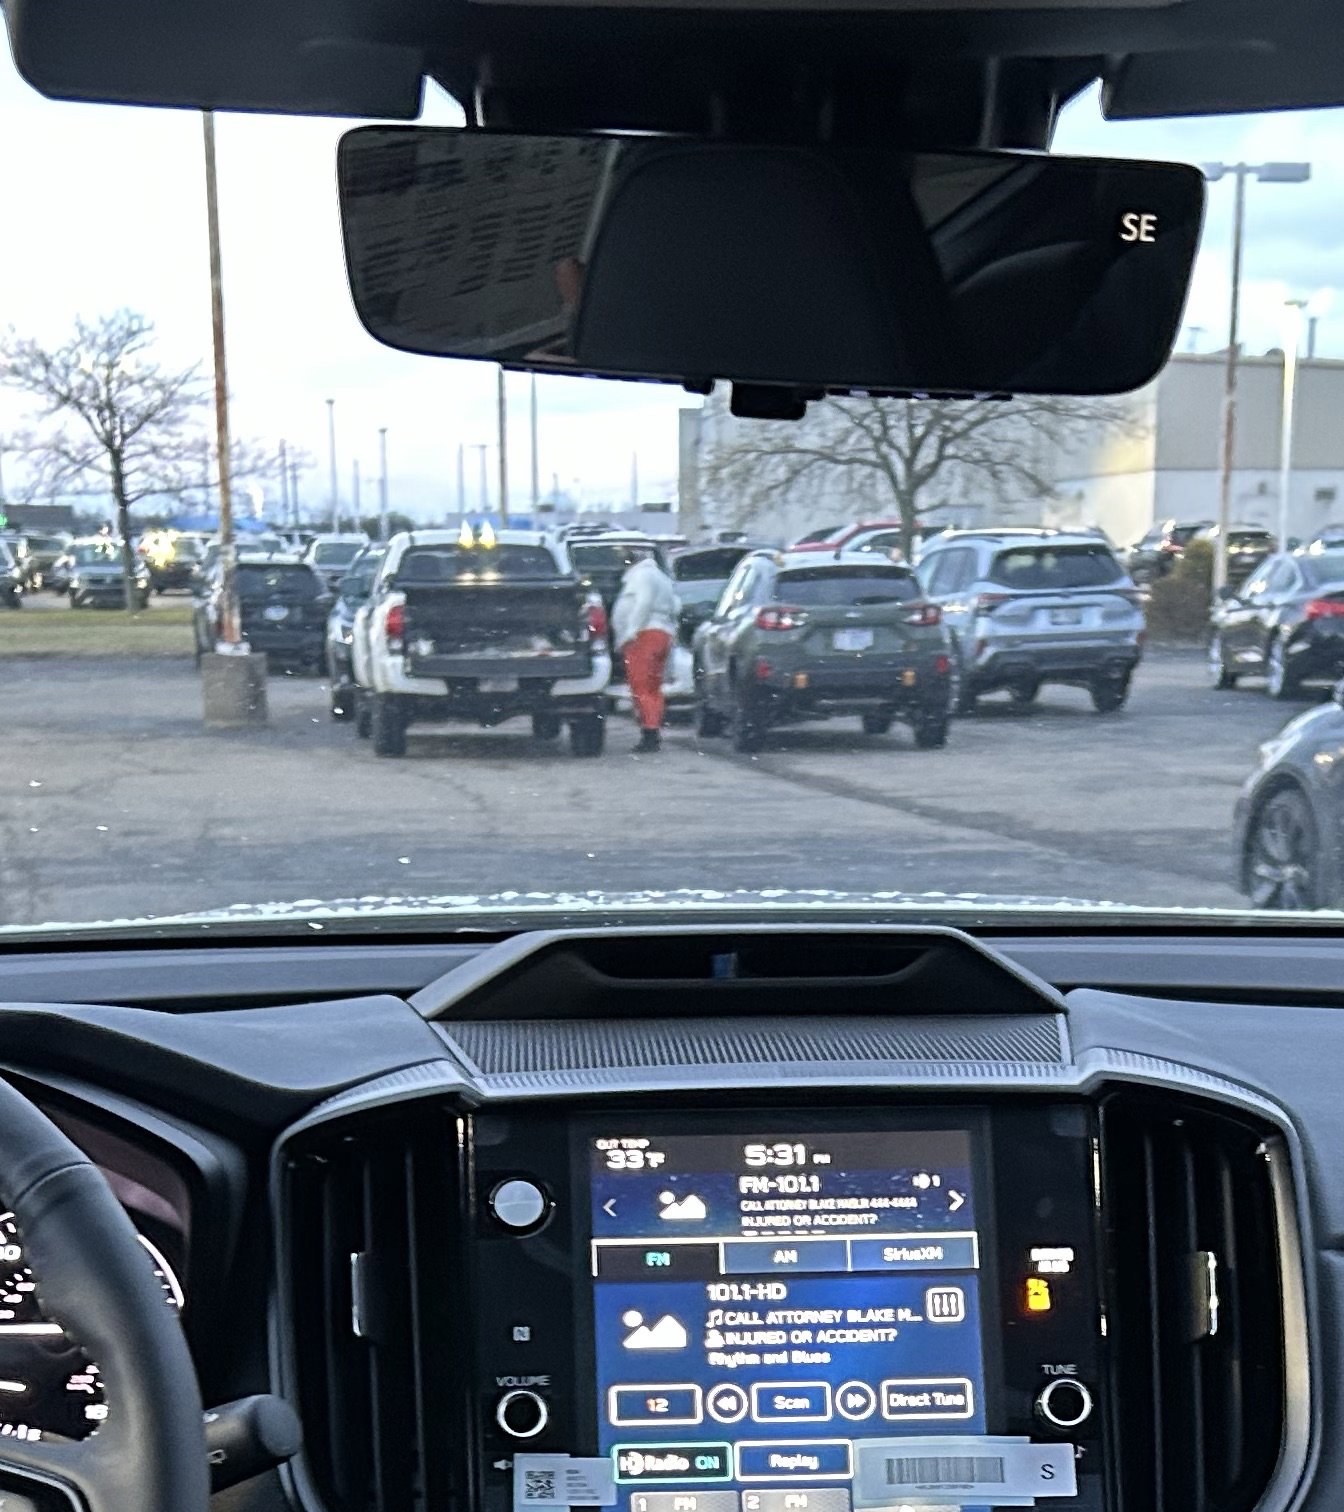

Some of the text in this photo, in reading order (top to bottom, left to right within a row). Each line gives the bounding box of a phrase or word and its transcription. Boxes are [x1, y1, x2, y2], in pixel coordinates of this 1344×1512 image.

[1119, 212, 1158, 242] SE
[744, 1144, 806, 1166] 5:31
[739, 1174, 821, 1194] FM-101.1
[793, 1215, 812, 1226] OR
[645, 1252, 671, 1267] FM
[773, 1249, 798, 1264] AM
[883, 1246, 944, 1262] SiriusXM
[706, 1282, 788, 1302] 101.1-HD
[724, 1310, 765, 1327] CALL
[766, 1309, 843, 1326] ATTORNEY
[846, 1308, 896, 1323] BLAKE
[724, 1328, 899, 1347] INJURED OR ACCIDENT?
[762, 1350, 790, 1366] and
[791, 1350, 833, 1365] Blues
[1041, 1364, 1079, 1375] TUNE
[495, 1375, 552, 1387] VOLUME
[773, 1395, 811, 1411] Scan
[889, 1391, 967, 1408] Direct Tune
[694, 1455, 721, 1471] ON
[769, 1453, 820, 1471] Replay
[1040, 1463, 1055, 1480] S
[638, 1497, 648, 1512] 1
[673, 1496, 697, 1511] FM
[747, 1495, 760, 1510] 2
[784, 1494, 808, 1509] FM
